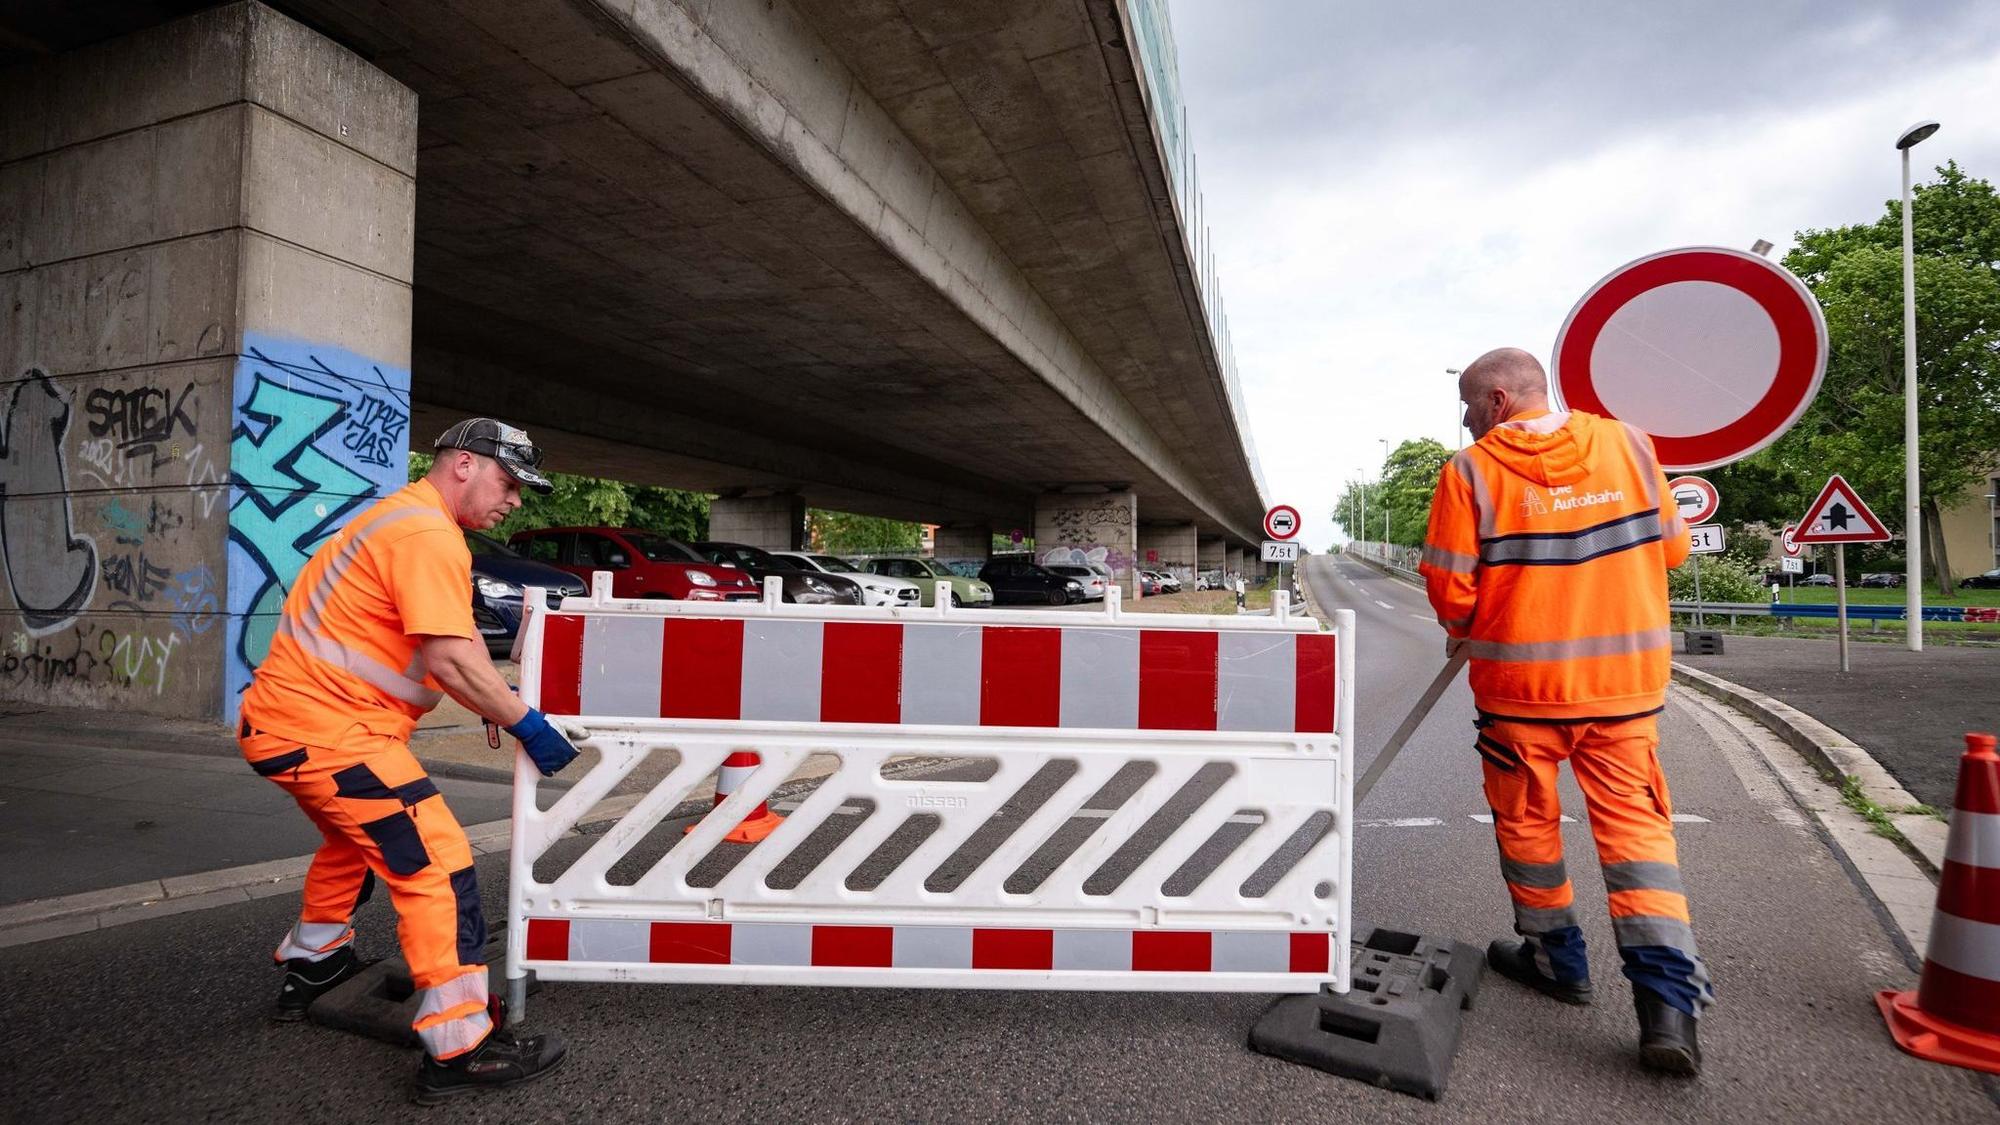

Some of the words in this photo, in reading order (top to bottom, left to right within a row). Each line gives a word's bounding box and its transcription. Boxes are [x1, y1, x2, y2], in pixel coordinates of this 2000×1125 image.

[85, 382, 198, 441] SATEK
[1552, 489, 1625, 512] Autobahn
[906, 788, 968, 809] nissen
